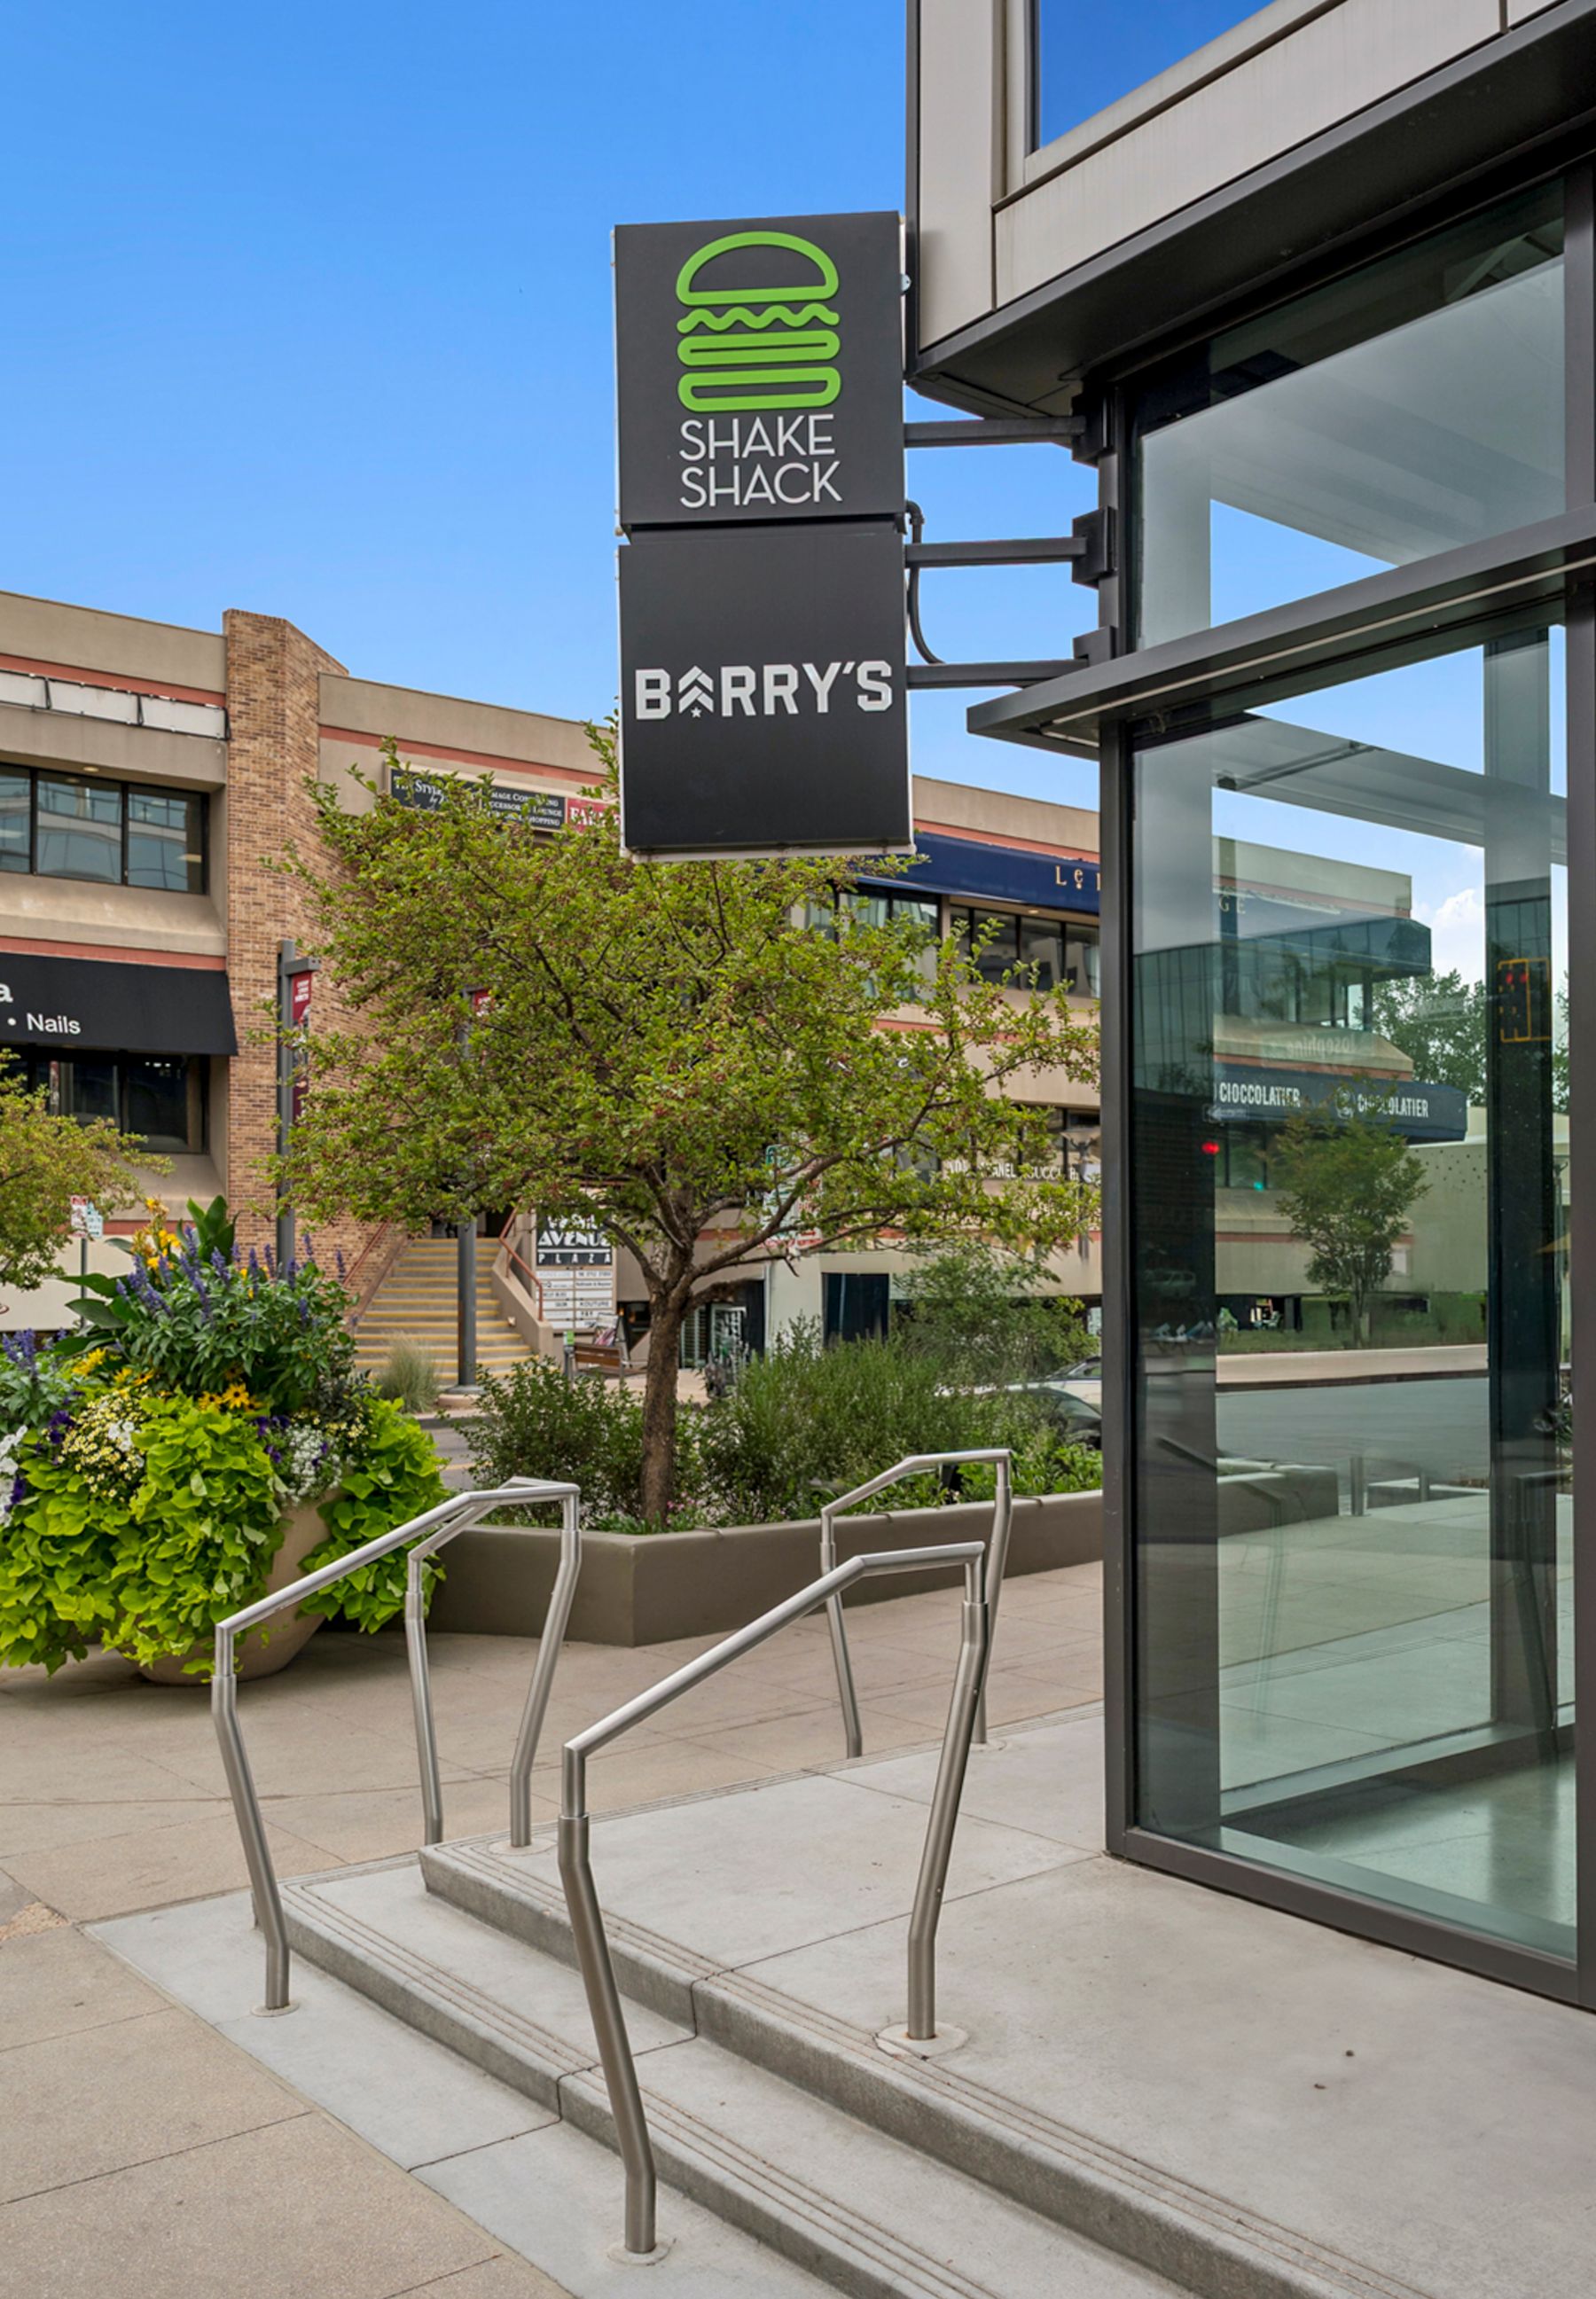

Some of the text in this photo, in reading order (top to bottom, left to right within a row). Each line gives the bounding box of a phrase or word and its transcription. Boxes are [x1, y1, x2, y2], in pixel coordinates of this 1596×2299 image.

[678, 414, 836, 460] SHAKE
[679, 461, 843, 508] SHACK
[26, 1013, 81, 1035] Nails
[538, 1254, 611, 1264] PLAZA
